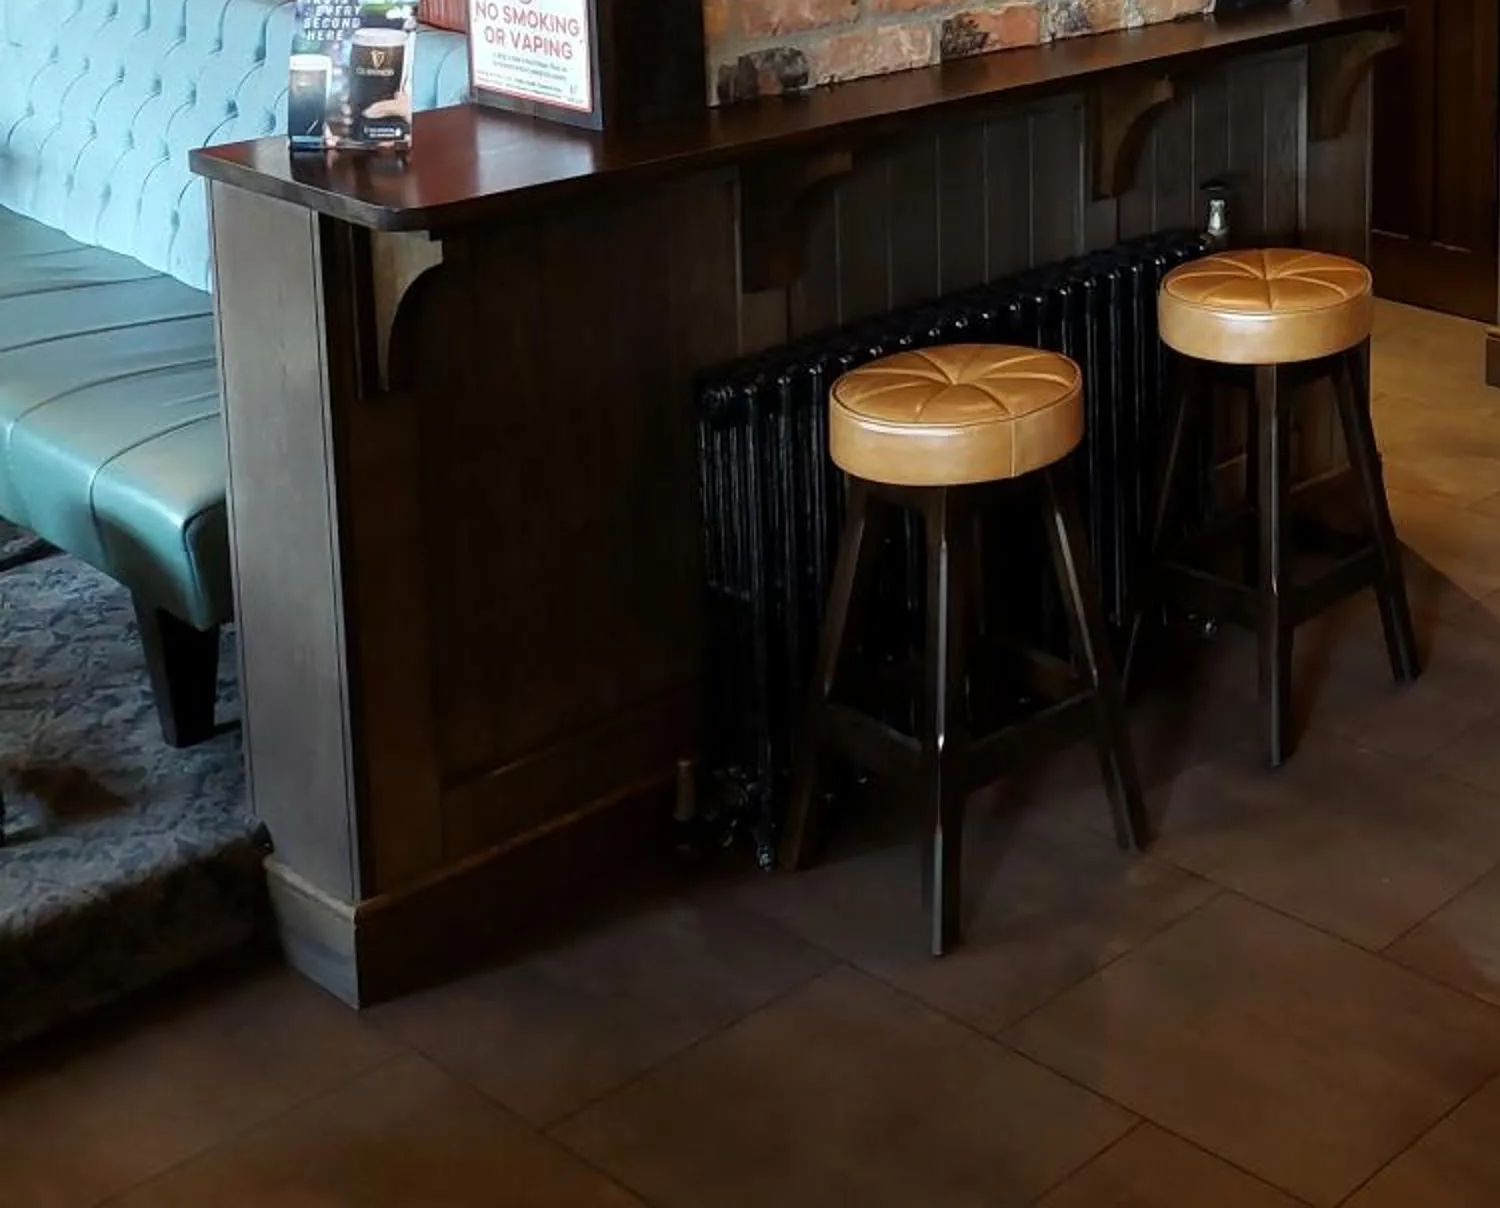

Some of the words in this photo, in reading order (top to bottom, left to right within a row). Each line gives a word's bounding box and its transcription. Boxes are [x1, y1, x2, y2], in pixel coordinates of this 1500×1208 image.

[303, 17, 360, 29] SECOND
[503, 5, 580, 37] SMOKING
[484, 25, 504, 47] OR
[510, 30, 573, 60] VAPING
